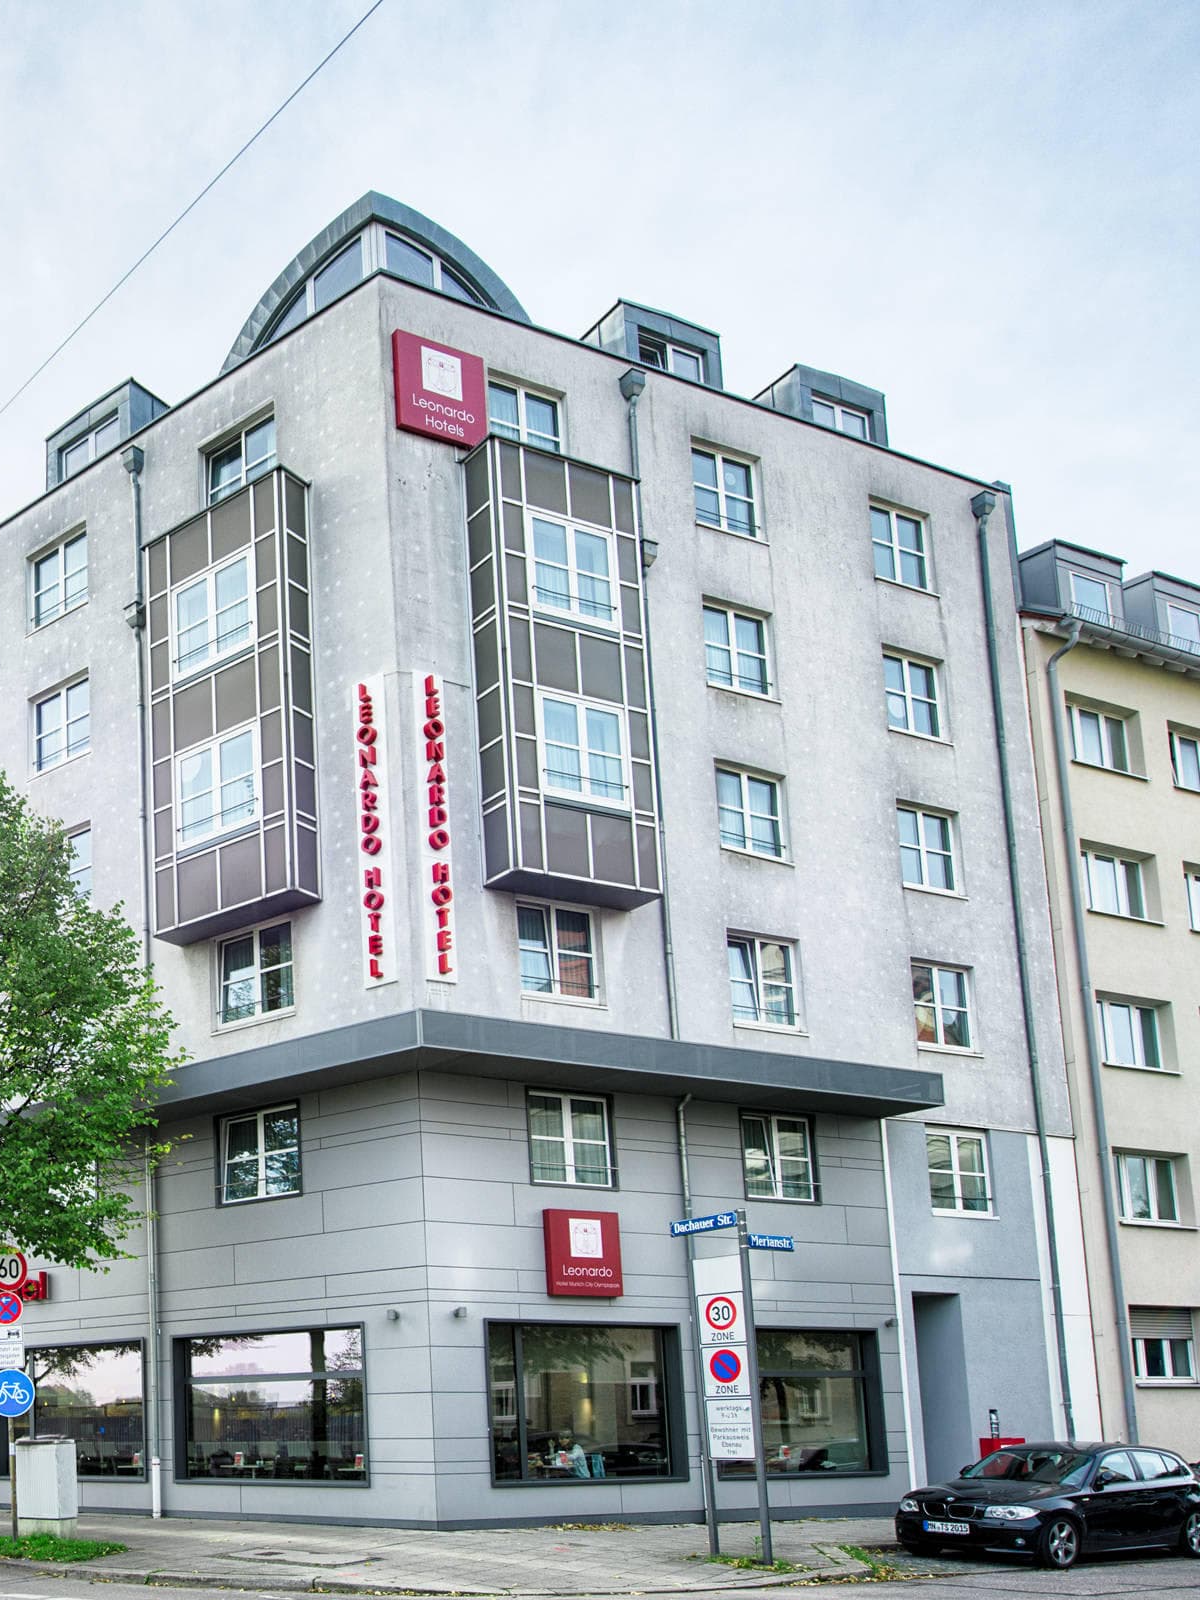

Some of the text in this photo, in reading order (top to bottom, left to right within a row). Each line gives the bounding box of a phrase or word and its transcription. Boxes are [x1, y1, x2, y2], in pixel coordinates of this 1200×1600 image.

[412, 392, 475, 424] Leonardo
[425, 414, 465, 437] Hotels
[356, 683, 385, 979] LEONARDO HOTEL
[423, 674, 453, 976] LEONARDO HOTEL
[673, 1214, 733, 1235] Dachauer Str.
[751, 1235, 792, 1249] Merianstr.
[562, 1263, 613, 1278] Leonardo
[711, 1305, 731, 1322] 30
[711, 1331, 735, 1341] ZONE
[715, 1384, 739, 1394] ZONE
